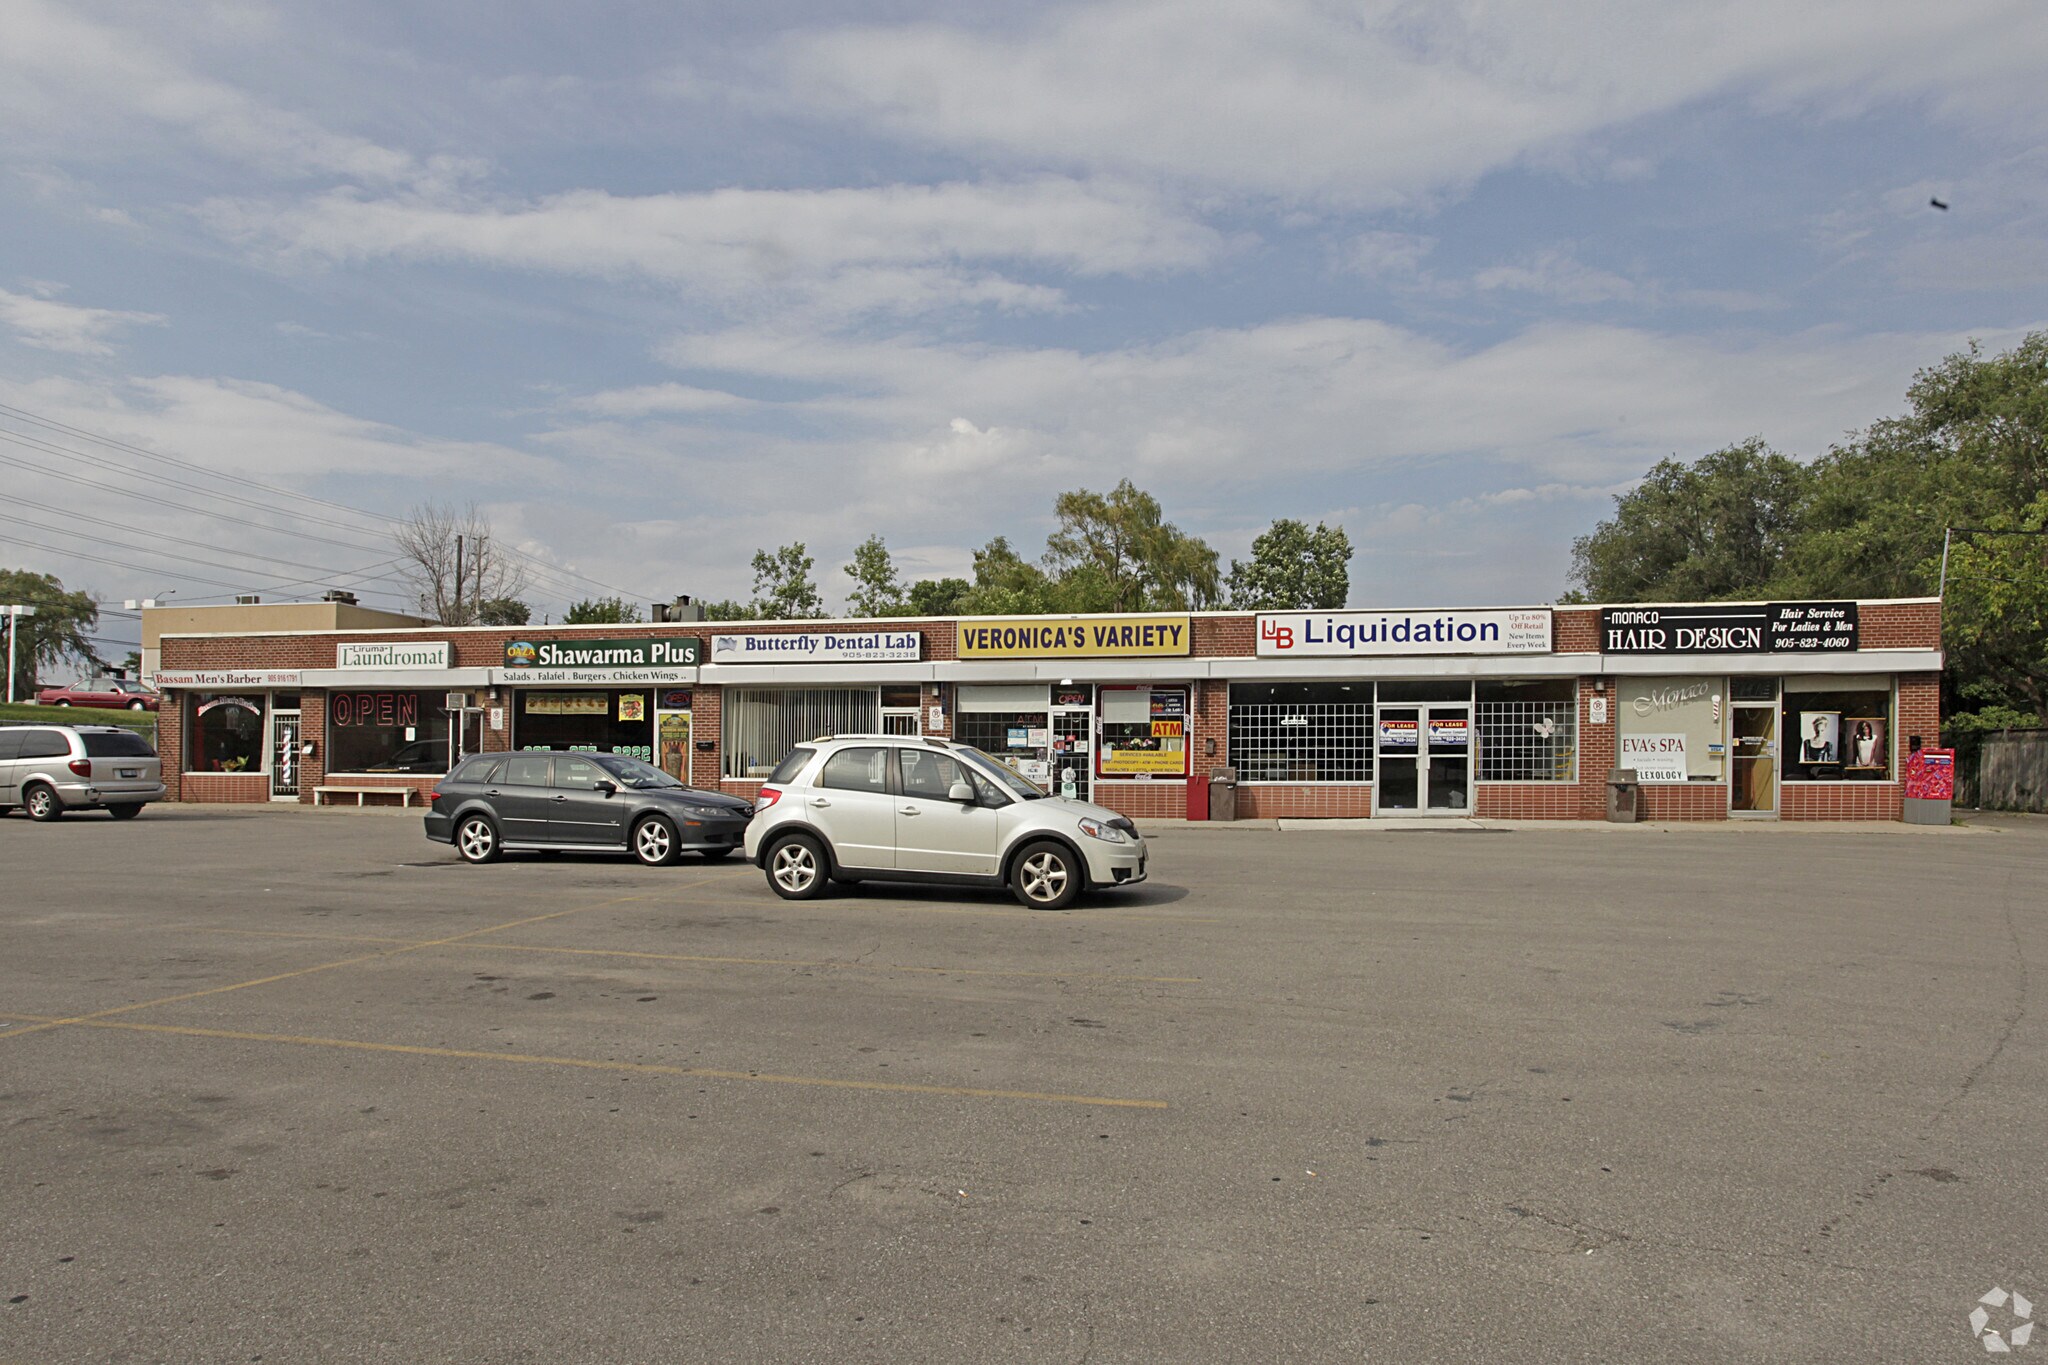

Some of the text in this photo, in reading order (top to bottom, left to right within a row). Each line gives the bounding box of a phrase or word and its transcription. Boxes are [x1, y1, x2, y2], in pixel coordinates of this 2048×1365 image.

[1509, 614, 1519, 622] Up
[1611, 611, 1659, 624] MONACO
[1780, 608, 1845, 619] Hair Service
[1305, 617, 1499, 649] Liquidation
[1771, 621, 1853, 632] For Ladies & Men
[964, 625, 1183, 649] VERONICA'S VARIETY
[1607, 627, 1762, 650] HAIR DESIGN
[1775, 637, 1850, 648] 905-823-4060
[745, 634, 916, 654] Butterfly Dental Lab
[343, 647, 444, 666] Laundromat
[507, 646, 536, 657] OAZA
[539, 642, 695, 665] Shawarma Plus
[156, 673, 262, 684] Bassam Men's Barber
[503, 671, 679, 682] Salads Falafel Burgers Chicken Wings
[1059, 694, 1085, 704] OPEN
[1633, 682, 1708, 712] Monaco
[333, 694, 418, 727] OPEN
[1153, 723, 1181, 736] ATM
[1623, 738, 1684, 752] EVA's SPA
